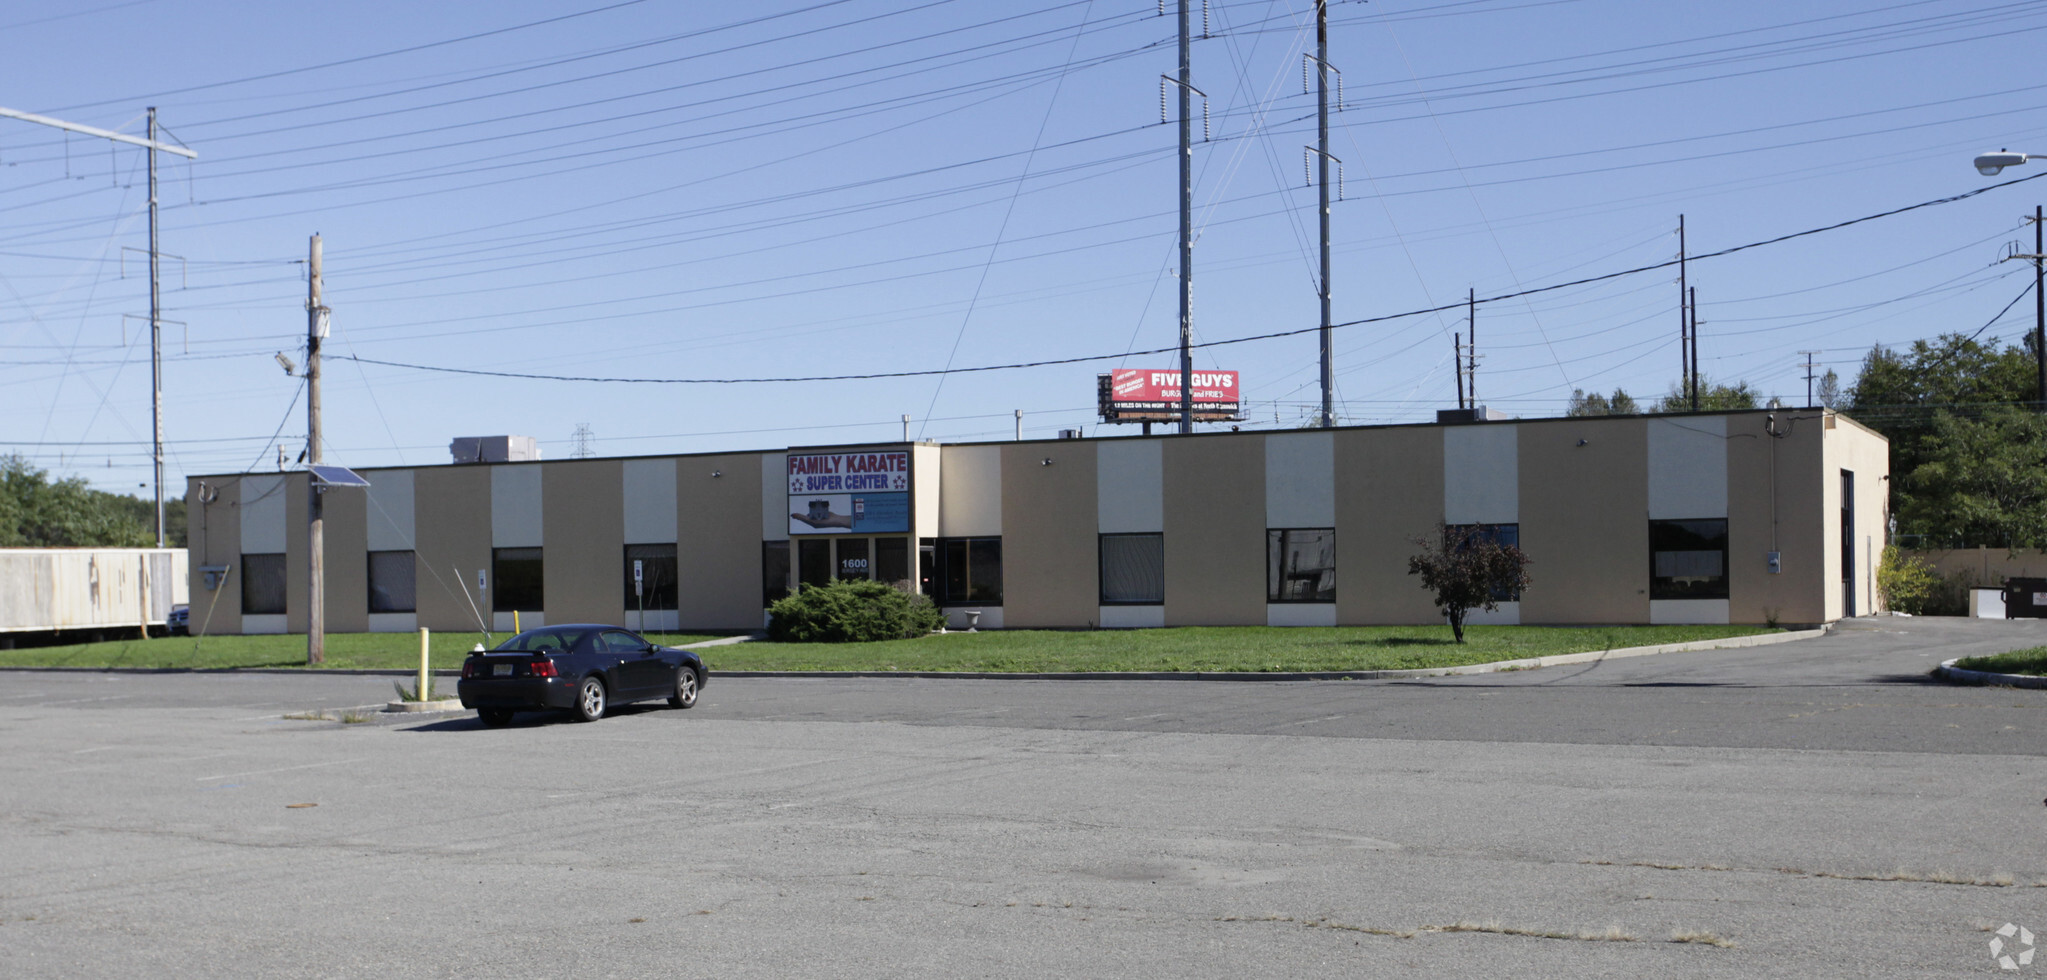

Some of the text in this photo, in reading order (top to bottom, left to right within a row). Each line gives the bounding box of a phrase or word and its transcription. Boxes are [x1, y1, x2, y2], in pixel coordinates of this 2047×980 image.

[1151, 373, 1182, 386] FIVE
[1191, 374, 1233, 388] GUYS
[789, 453, 906, 475] FAMILY KARATE
[806, 474, 889, 491] SUPER CENTER
[841, 559, 868, 568] 1600
